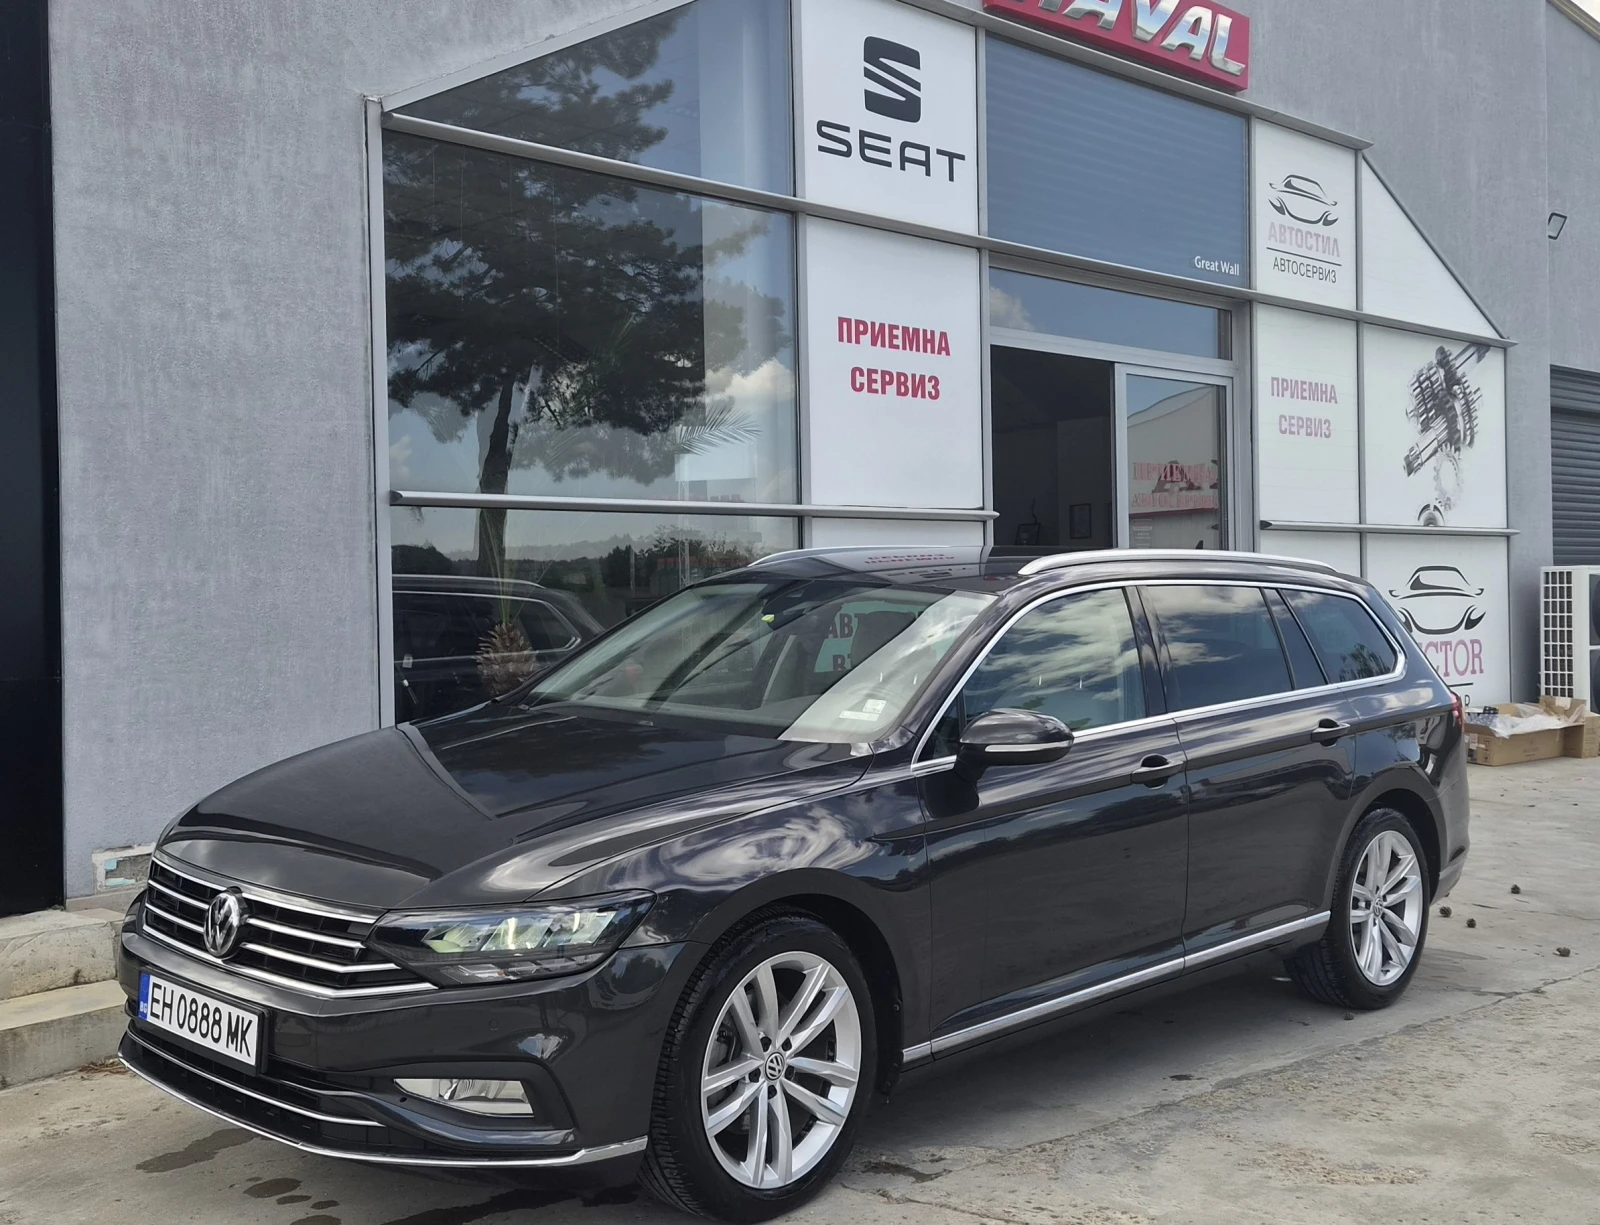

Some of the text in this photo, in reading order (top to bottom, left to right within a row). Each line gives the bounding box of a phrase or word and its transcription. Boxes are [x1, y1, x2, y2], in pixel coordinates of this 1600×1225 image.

[1013, 0, 1246, 76] AVAL
[816, 119, 966, 183] SEAT
[1268, 221, 1340, 258] АВТОСТИЛ
[1194, 255, 1239, 276] Great Wall
[1272, 256, 1337, 284] АВТОСЕРВИЗ
[837, 316, 951, 357] ПРИЕМНА
[850, 366, 940, 401] СЕРВИЗ
[1271, 376, 1338, 404] ПРИЕМНА
[1278, 414, 1332, 439] СЕРВИЗ
[139, 1001, 148, 1013] BG
[177, 993, 222, 1044] 0888
